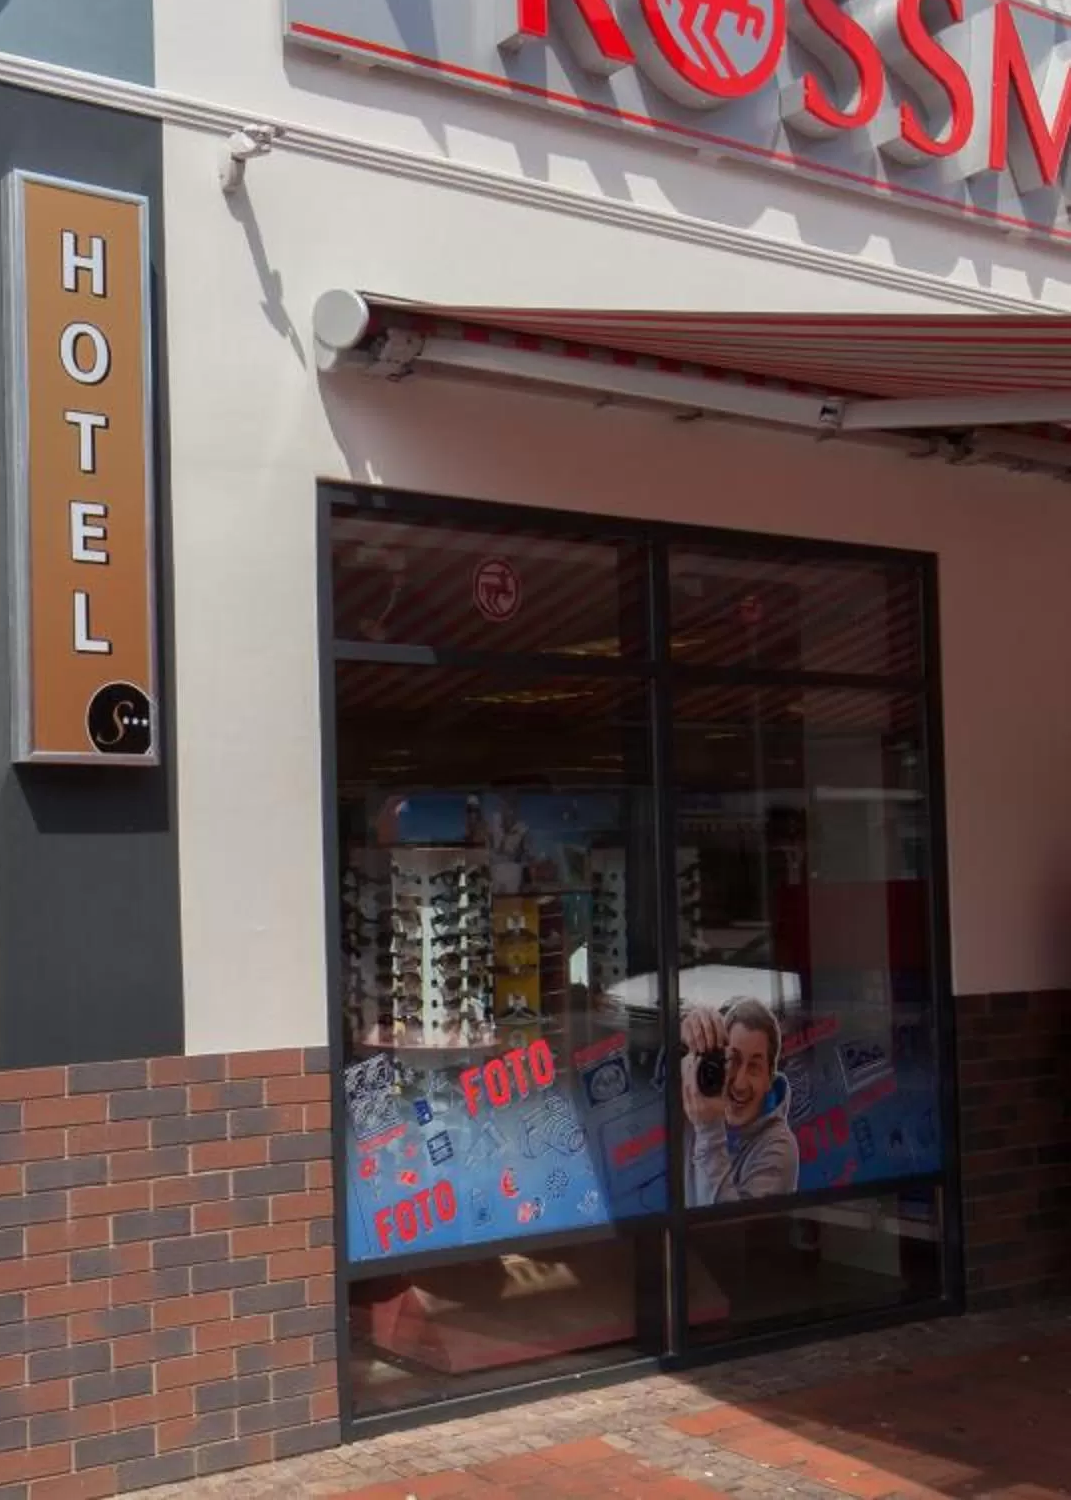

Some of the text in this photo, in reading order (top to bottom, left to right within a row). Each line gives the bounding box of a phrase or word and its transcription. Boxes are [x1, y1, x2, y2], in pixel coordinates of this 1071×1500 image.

[59, 229, 113, 656] HOTEL
[459, 1038, 555, 1117] FOTO
[374, 1179, 458, 1252] FOTO
